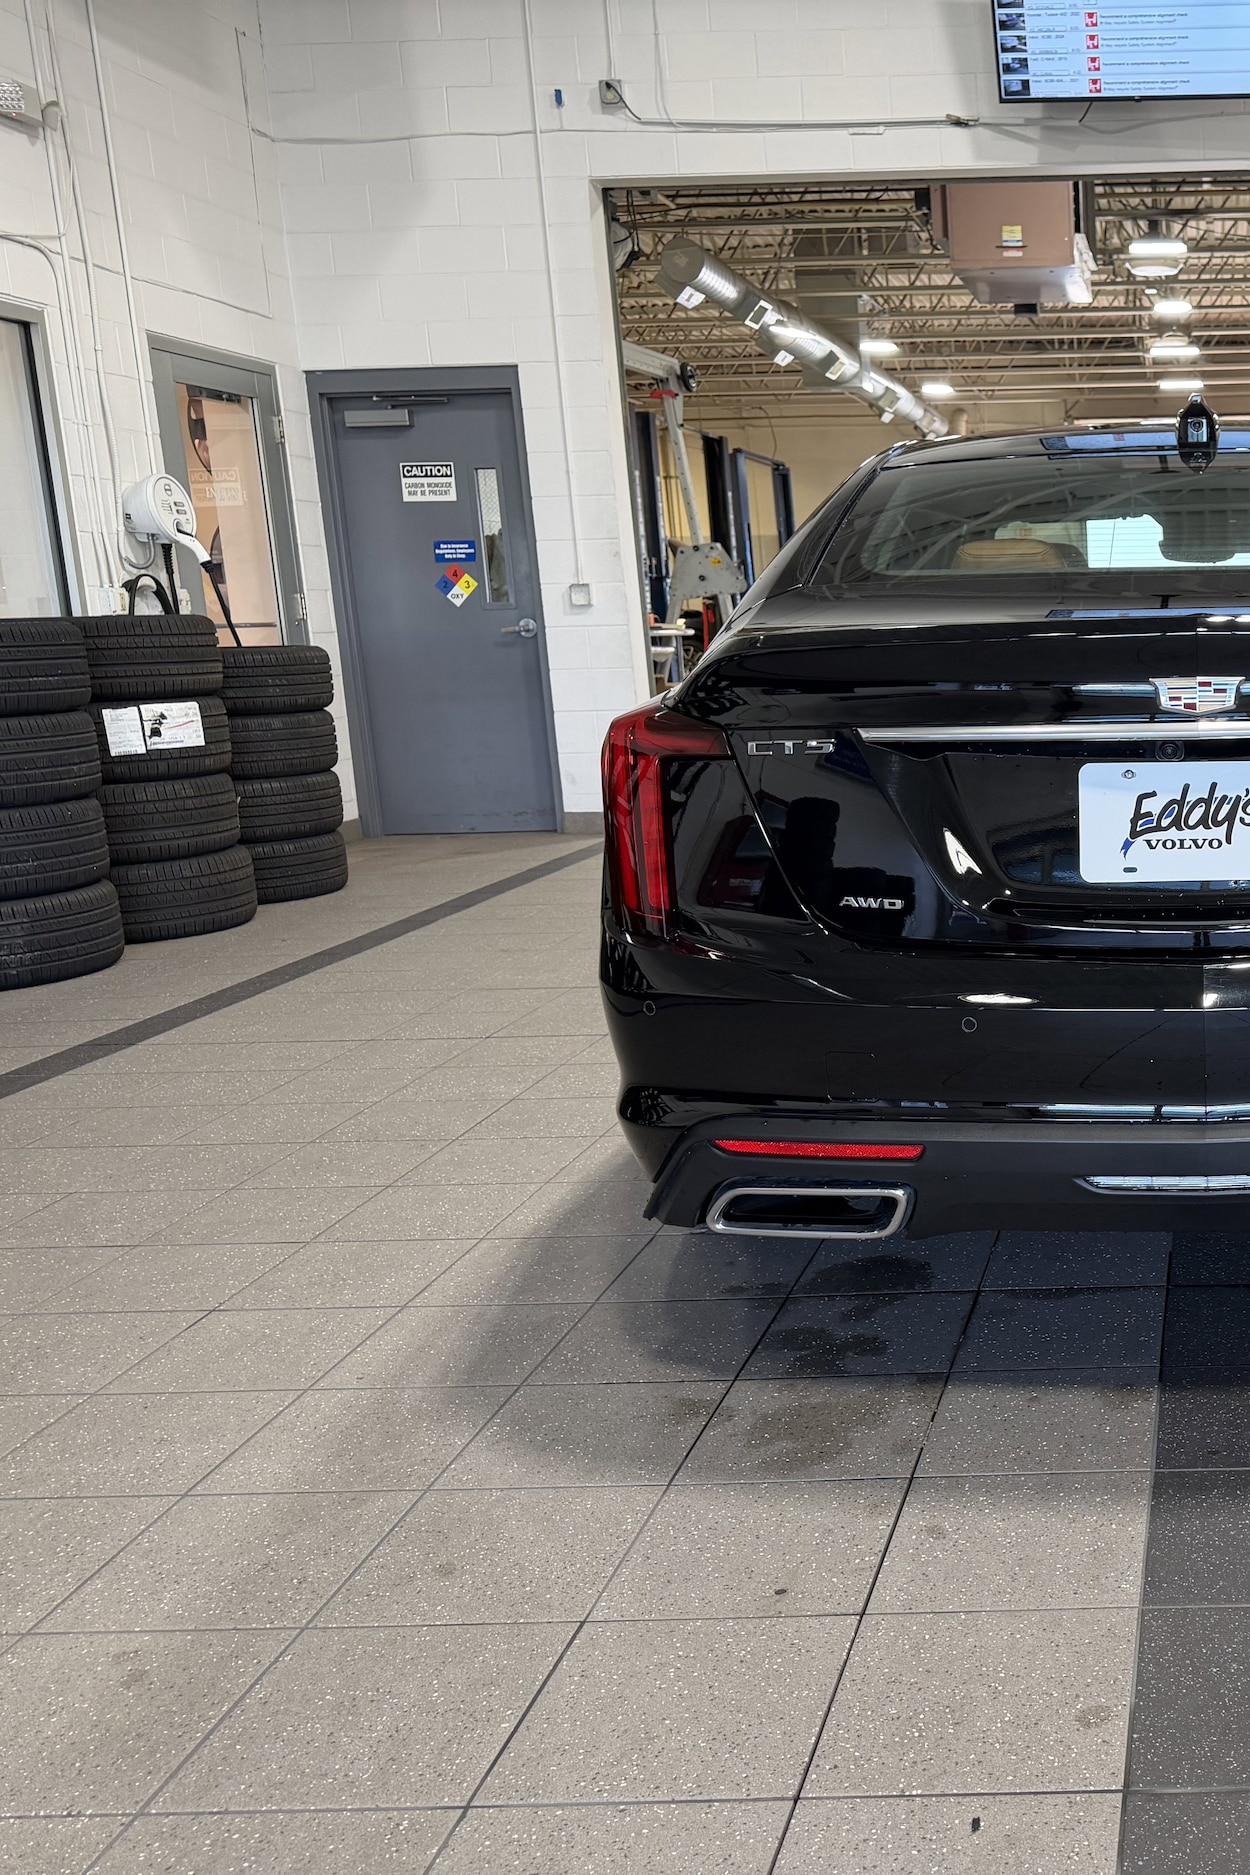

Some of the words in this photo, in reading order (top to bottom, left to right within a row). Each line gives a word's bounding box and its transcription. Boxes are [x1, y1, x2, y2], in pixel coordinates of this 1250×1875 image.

[403, 466, 451, 476] CAUTION
[452, 569, 458, 578] 4
[442, 580, 449, 589] 2
[464, 580, 471, 589] 3
[1143, 838, 1223, 850] VOLVO
[838, 896, 904, 910] AWD
